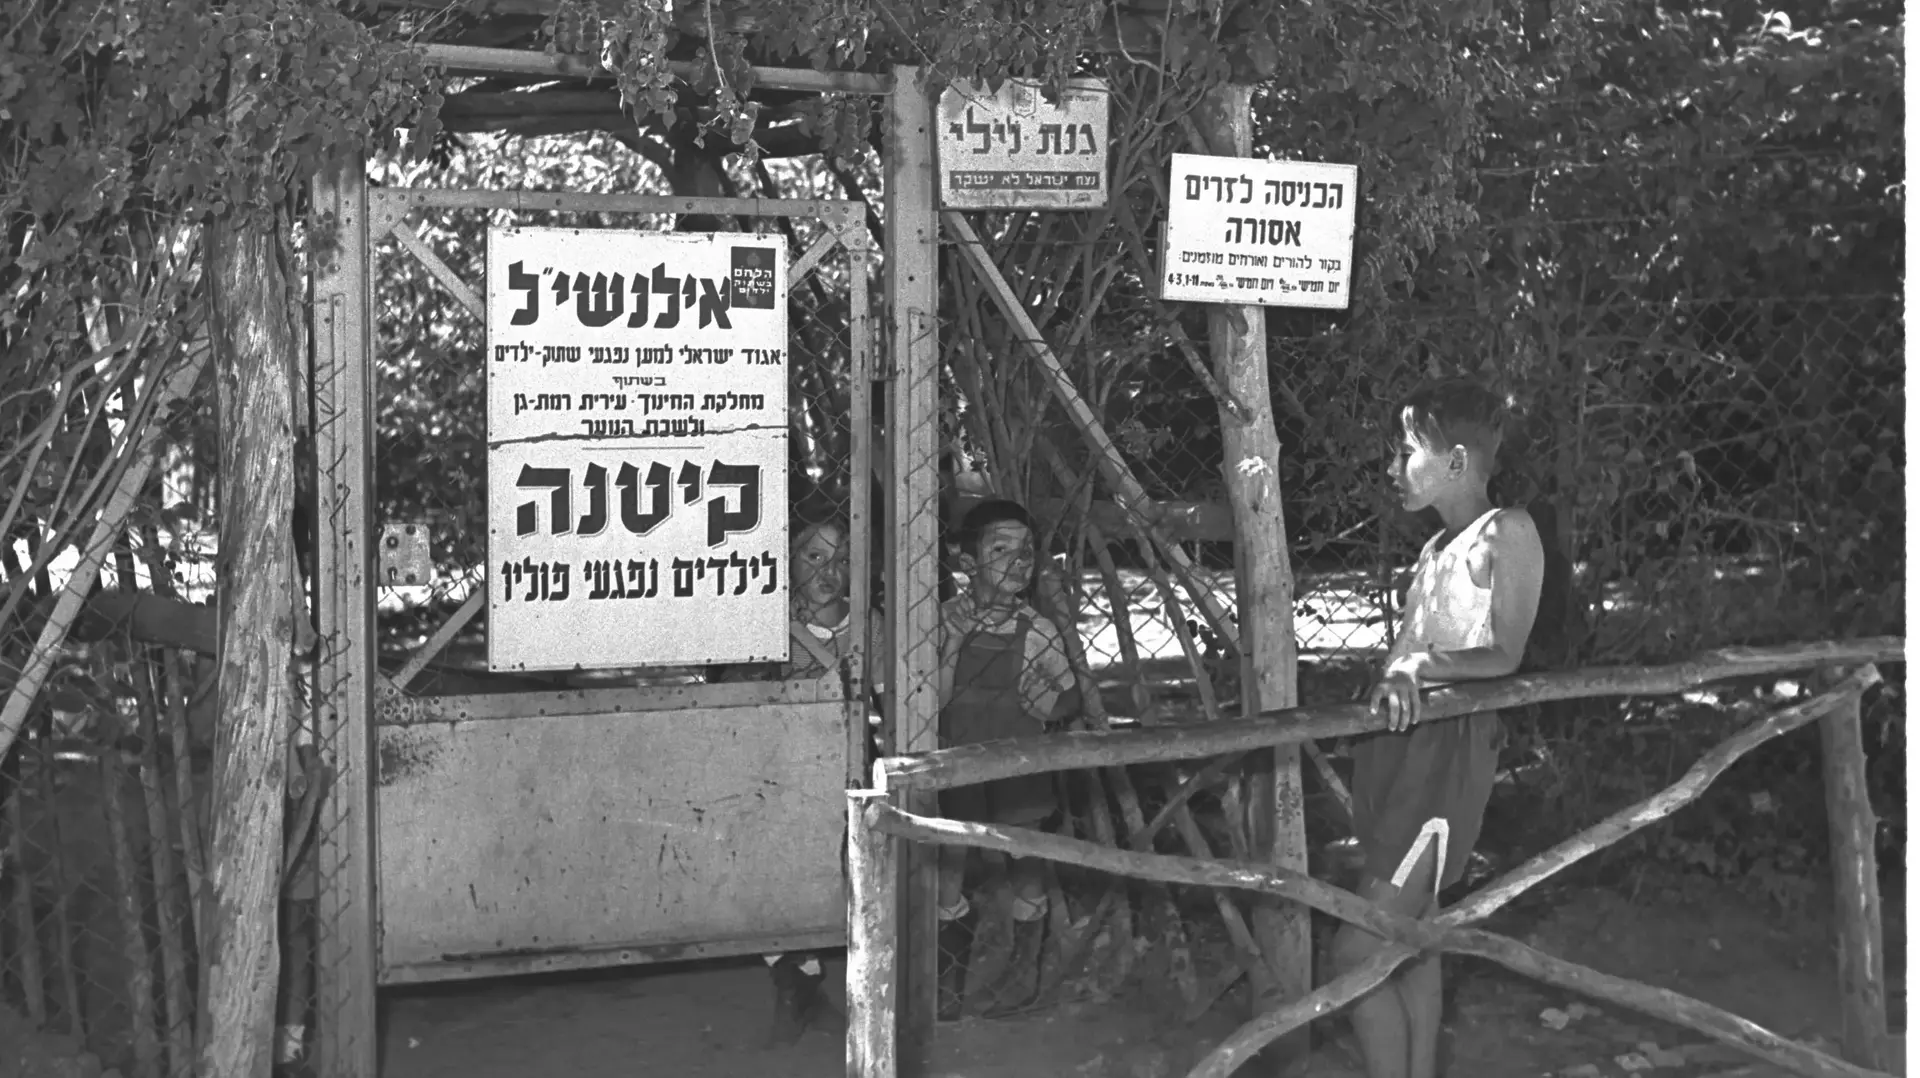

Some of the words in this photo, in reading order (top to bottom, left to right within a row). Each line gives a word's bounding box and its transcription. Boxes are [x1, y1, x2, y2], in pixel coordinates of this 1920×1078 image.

[1036, 123, 1097, 155] גנת
[954, 174, 994, 187] ישקר
[1001, 172, 1021, 185] לא
[1025, 172, 1068, 185] ישראל
[1075, 175, 1096, 185] נצח
[1184, 174, 1253, 203] לזרים
[1264, 180, 1344, 209] הכניסה
[1225, 217, 1302, 246] אסורה
[1228, 252, 1268, 267] ואורחים
[1272, 254, 1313, 269] להורים
[1318, 258, 1342, 273] בקור
[734, 268, 772, 278] הלחם
[1327, 280, 1341, 293] יום
[587, 346, 630, 363] נפגעי
[635, 344, 674, 367] למען
[678, 344, 734, 364] ישראלי
[740, 348, 782, 365] אגוד
[612, 376, 667, 390] בשתוף
[513, 394, 572, 415] רמת-גן
[578, 393, 627, 410] עירית
[638, 394, 695, 417] החינוך
[700, 391, 765, 413] מחלקת
[580, 419, 634, 437] הנוער
[516, 459, 763, 549] קיטנה
[500, 556, 571, 602] פוליו
[583, 558, 659, 600] נפגעי
[671, 550, 778, 597] לילדים
